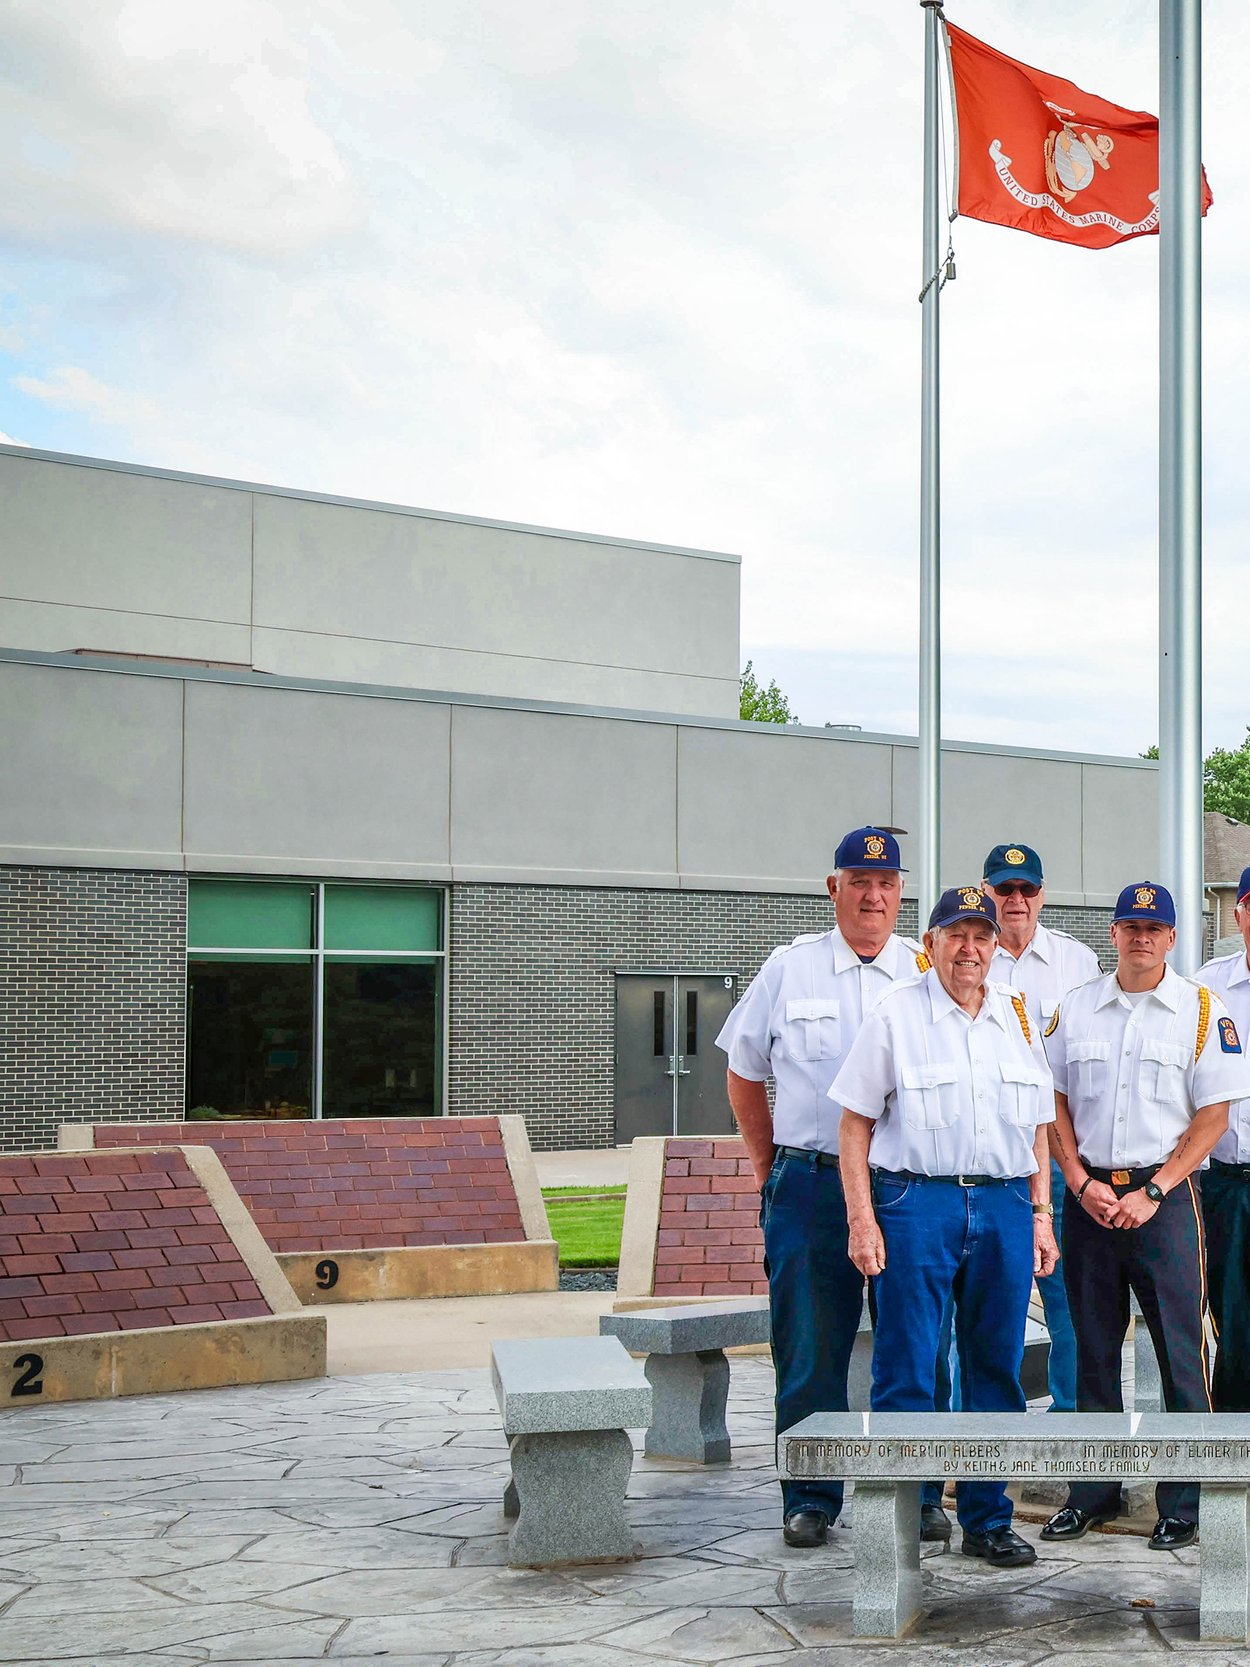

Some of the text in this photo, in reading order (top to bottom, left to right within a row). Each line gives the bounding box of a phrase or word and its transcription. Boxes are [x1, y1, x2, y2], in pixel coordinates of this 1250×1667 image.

[998, 167, 1039, 207] UNITED
[1042, 194, 1076, 224] STATES
[1079, 213, 1124, 232] MARINE
[724, 977, 733, 989] 9
[315, 1260, 339, 1290] 9
[11, 1354, 44, 1396] 2
[816, 1444, 871, 1457] MEMORY
[878, 1444, 893, 1457] OF
[900, 1444, 947, 1457] MERLIN
[953, 1444, 1001, 1457] ALBERS
[1084, 1445, 1096, 1458] IN
[1102, 1445, 1158, 1458] MEMORY
[1166, 1445, 1181, 1458] OF
[1188, 1445, 1231, 1458] ELMER
[944, 1460, 1150, 1473] BY KEITH & JANE THOMSEN & FAMILY
